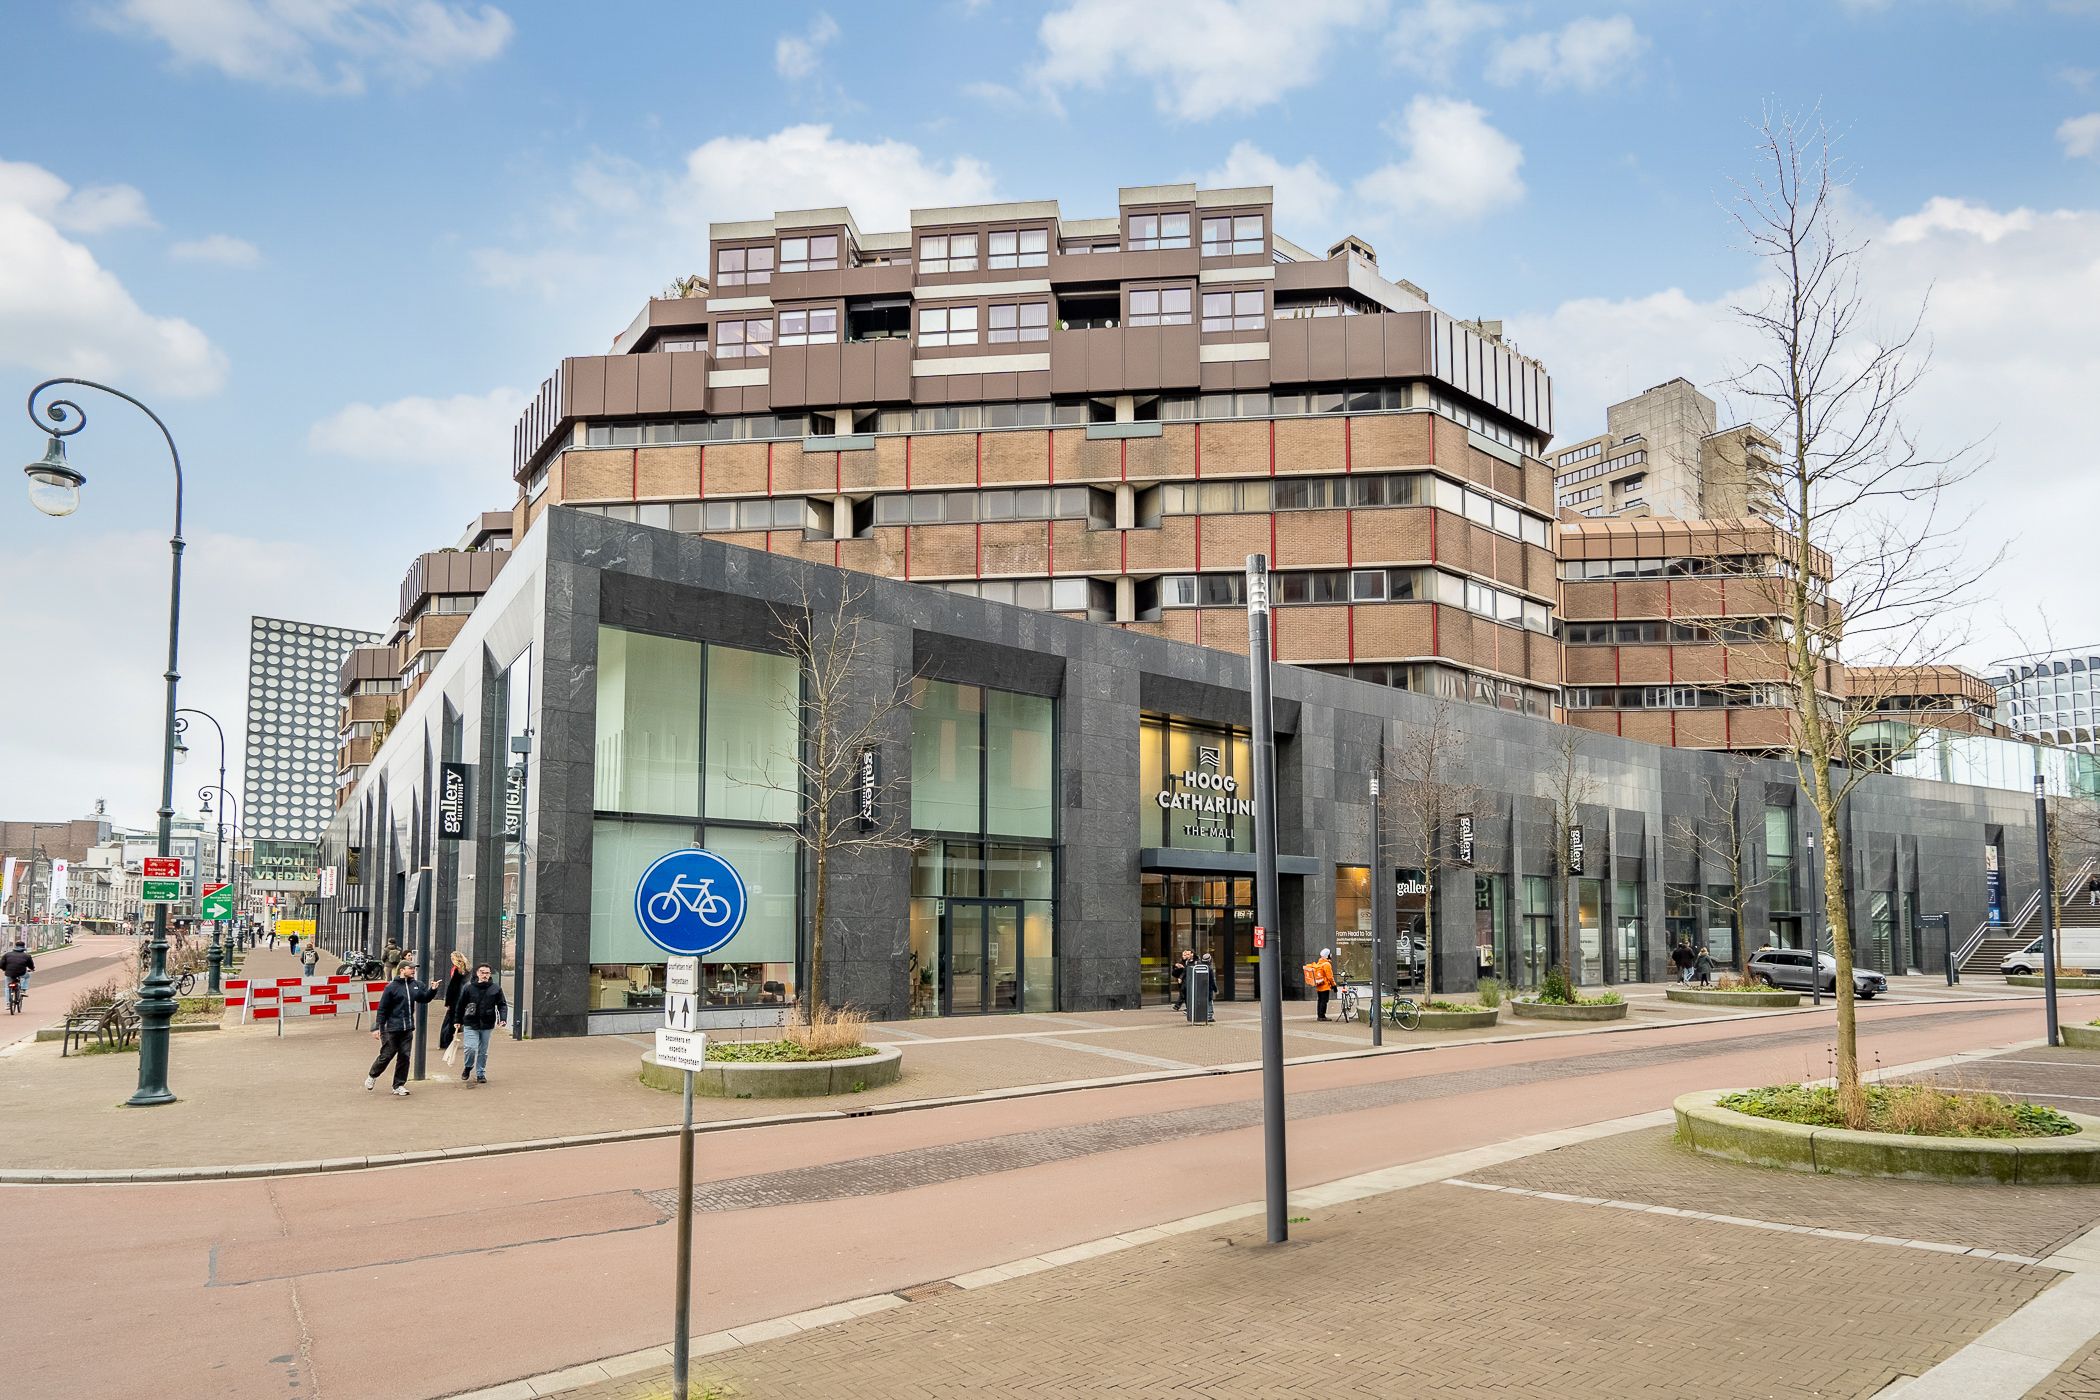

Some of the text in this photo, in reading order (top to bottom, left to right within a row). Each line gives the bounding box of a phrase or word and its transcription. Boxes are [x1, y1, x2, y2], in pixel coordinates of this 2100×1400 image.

[863, 752, 875, 822] gallery
[1184, 770, 1236, 792] HOOG
[440, 769, 462, 833] gallery
[1184, 825, 1236, 839] THE MALL
[1460, 817, 1474, 863] gallery
[260, 856, 305, 866] TIVOLI
[1570, 829, 1583, 872] gallery
[1400, 930, 1410, 948] 5
